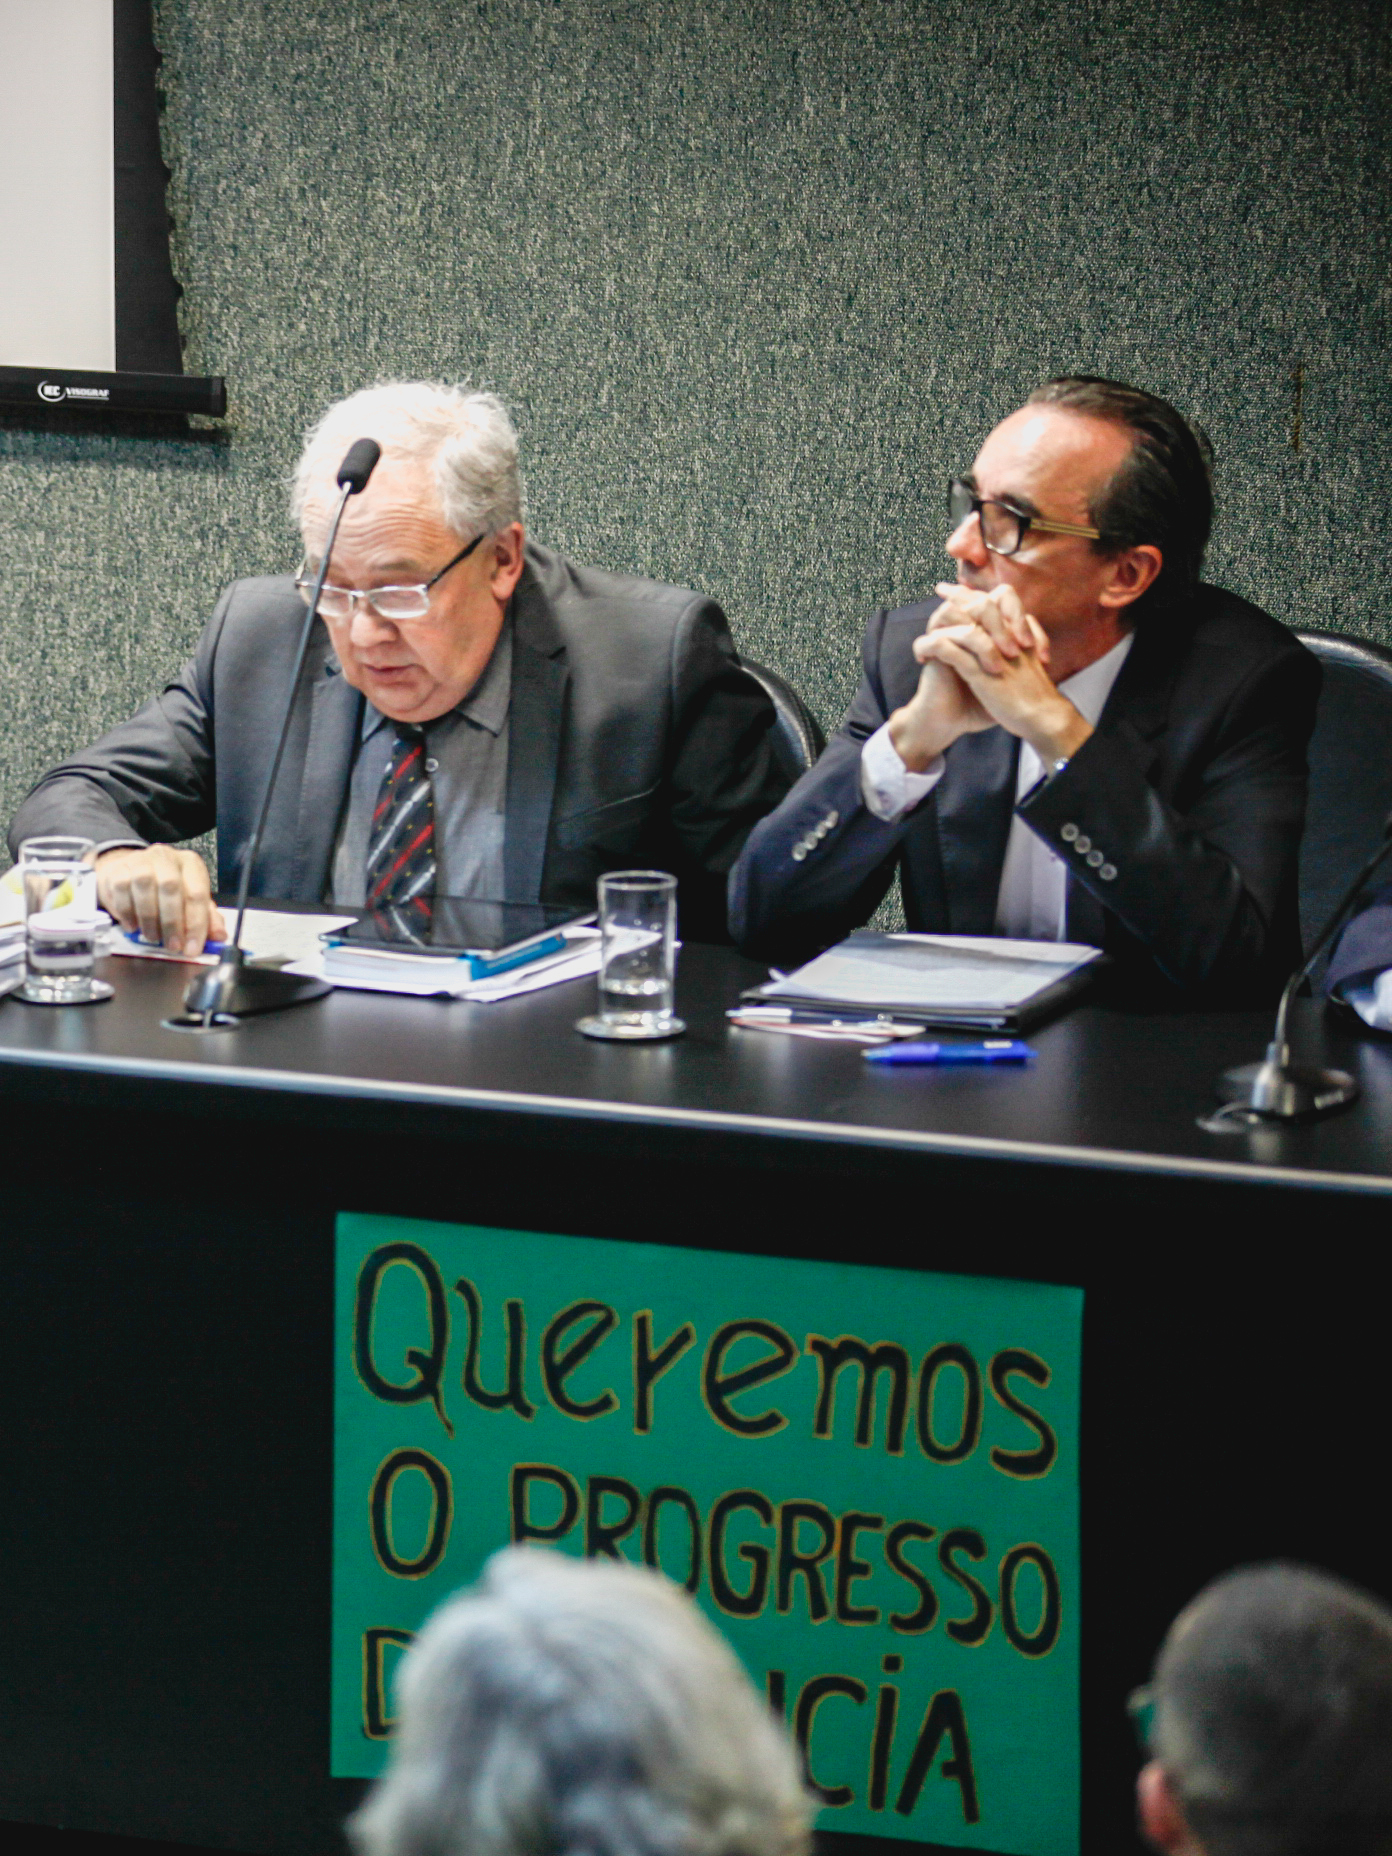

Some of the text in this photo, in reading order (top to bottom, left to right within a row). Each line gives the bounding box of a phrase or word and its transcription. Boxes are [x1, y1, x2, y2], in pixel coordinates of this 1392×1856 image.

[353, 1240, 1057, 1480] Queremos
[368, 1447, 1062, 1659] O PROGRESSO
